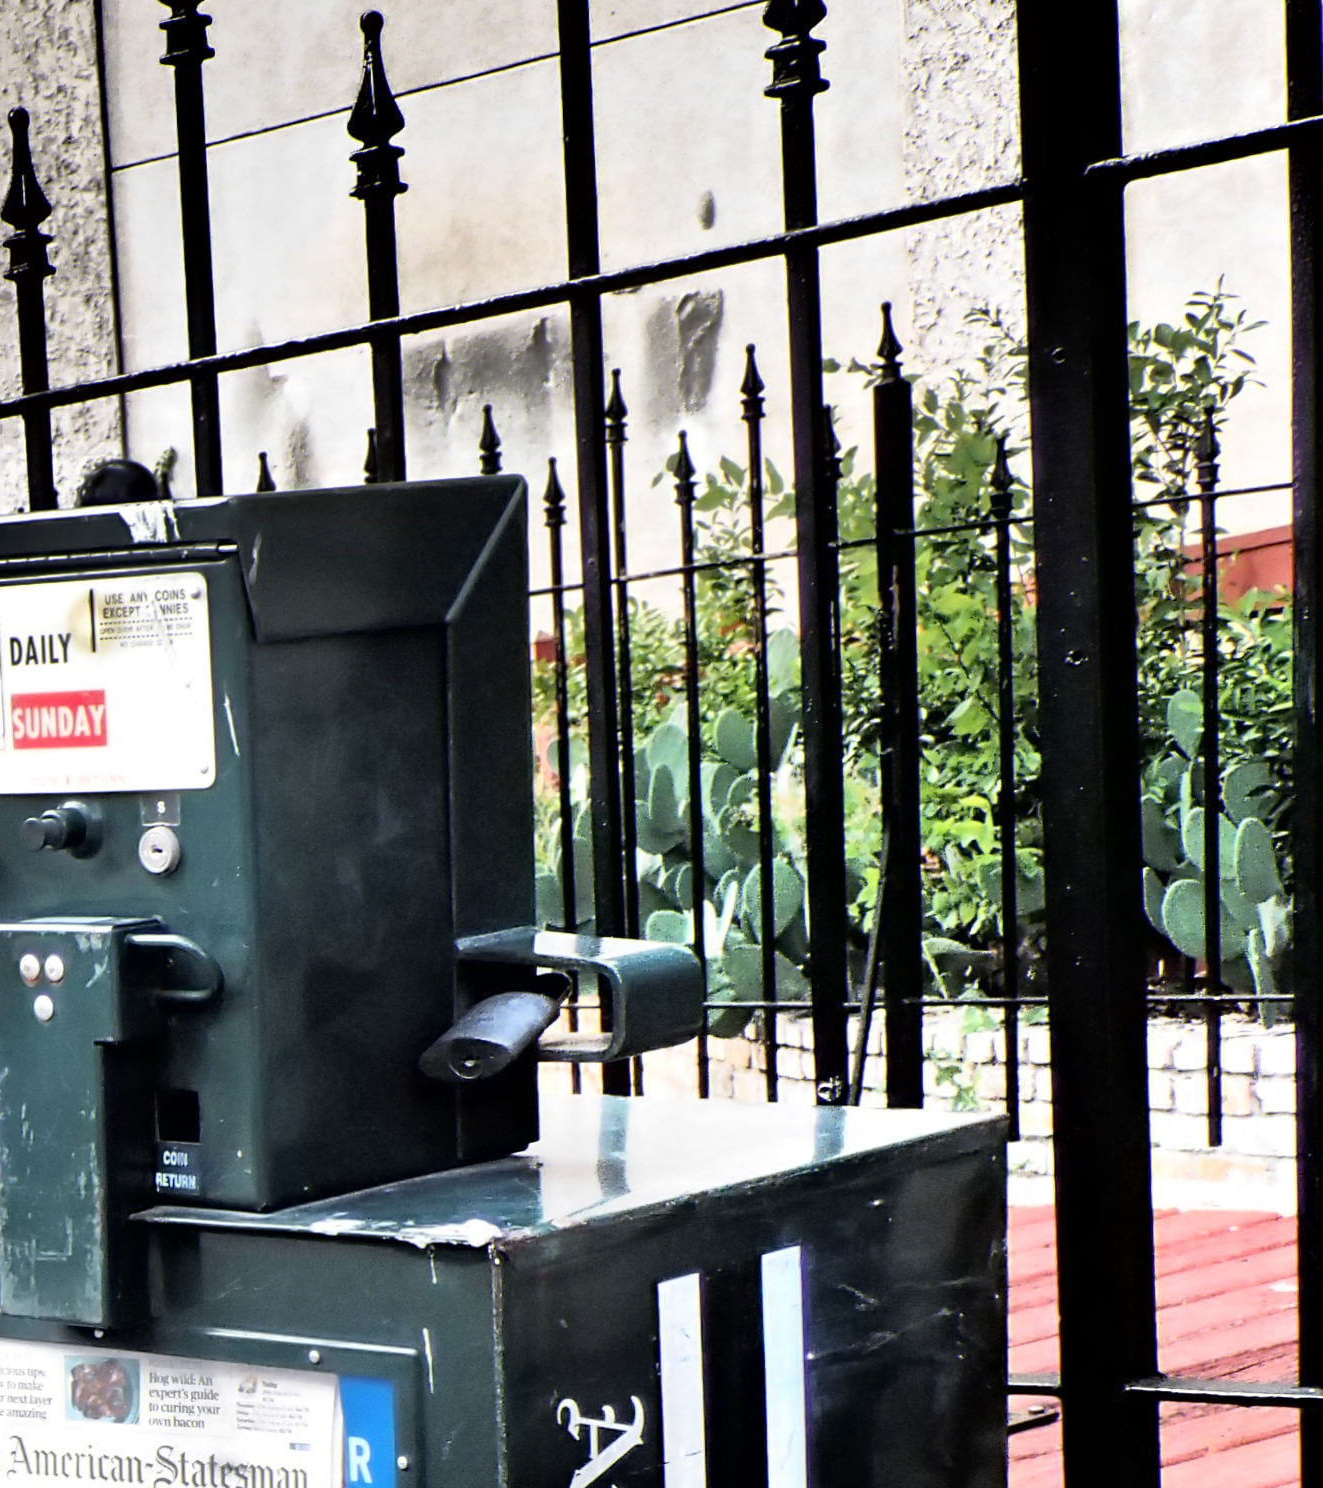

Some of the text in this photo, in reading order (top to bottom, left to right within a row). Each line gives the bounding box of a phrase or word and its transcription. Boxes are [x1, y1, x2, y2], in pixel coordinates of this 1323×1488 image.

[105, 593, 124, 605] USE
[155, 588, 186, 602] COINS
[102, 606, 140, 619] EXCEPT
[10, 633, 72, 667] DAILY
[12, 703, 106, 740] SUNDAY
[163, 1150, 188, 1167] COIN
[155, 1172, 196, 1190] RETURN
[7, 1379, 16, 1389] to
[18, 1381, 44, 1391] make
[149, 1372, 213, 1387] Hog wild: An
[7, 1393, 27, 1404] next
[29, 1395, 53, 1407] layer
[149, 1388, 220, 1402] expert's guide
[6, 1408, 47, 1420] amazing
[149, 1402, 221, 1417] to curing your
[148, 1417, 205, 1429] own bacon
